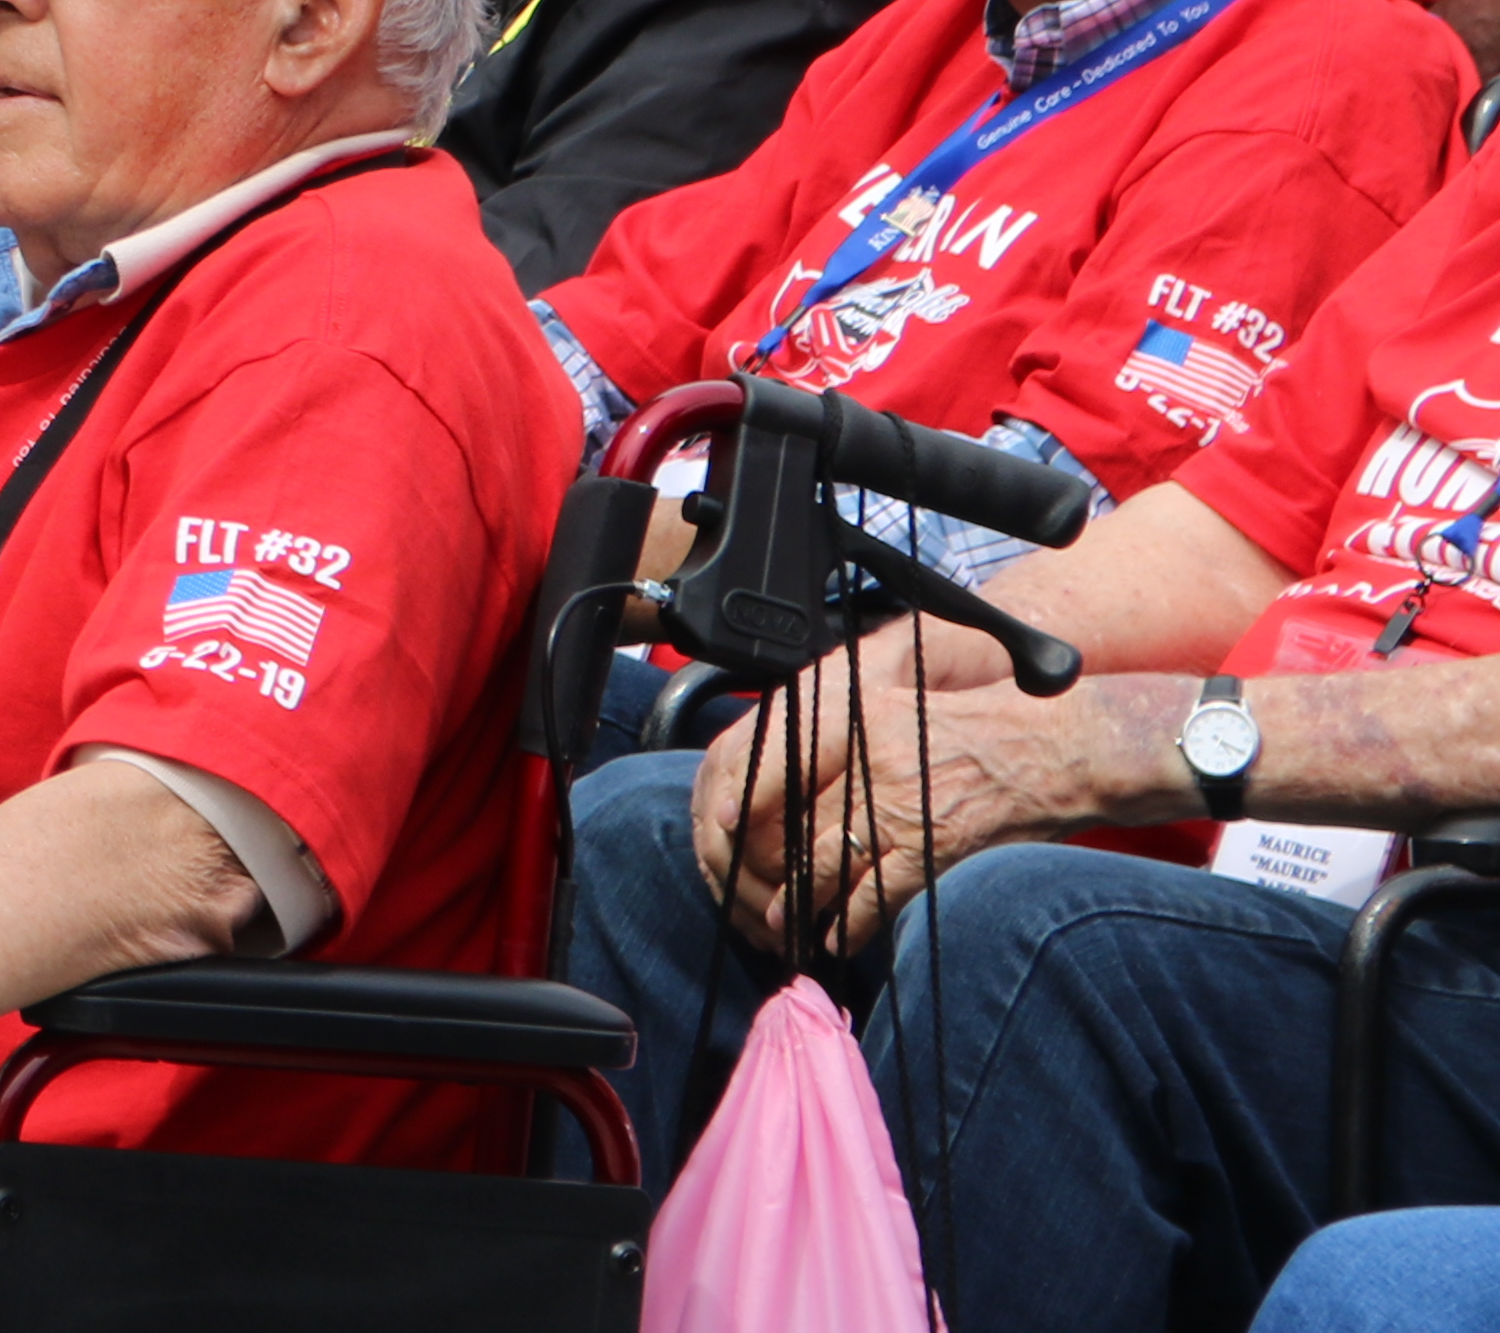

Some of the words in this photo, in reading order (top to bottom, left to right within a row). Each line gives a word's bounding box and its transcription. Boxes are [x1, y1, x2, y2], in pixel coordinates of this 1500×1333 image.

[975, 108, 1033, 151] Genuine
[1033, 83, 1074, 115] Care
[1081, 30, 1159, 86] Dedicated
[1157, 19, 1180, 40] To
[1180, 0, 1210, 24] You
[1146, 272, 1213, 322] FLT
[1210, 299, 1286, 364] #32
[1355, 423, 1499, 513] HON
[174, 515, 250, 565] FLT
[253, 528, 353, 592] #32
[137, 639, 307, 712] 5-22-19
[1257, 833, 1333, 865] MAURICE
